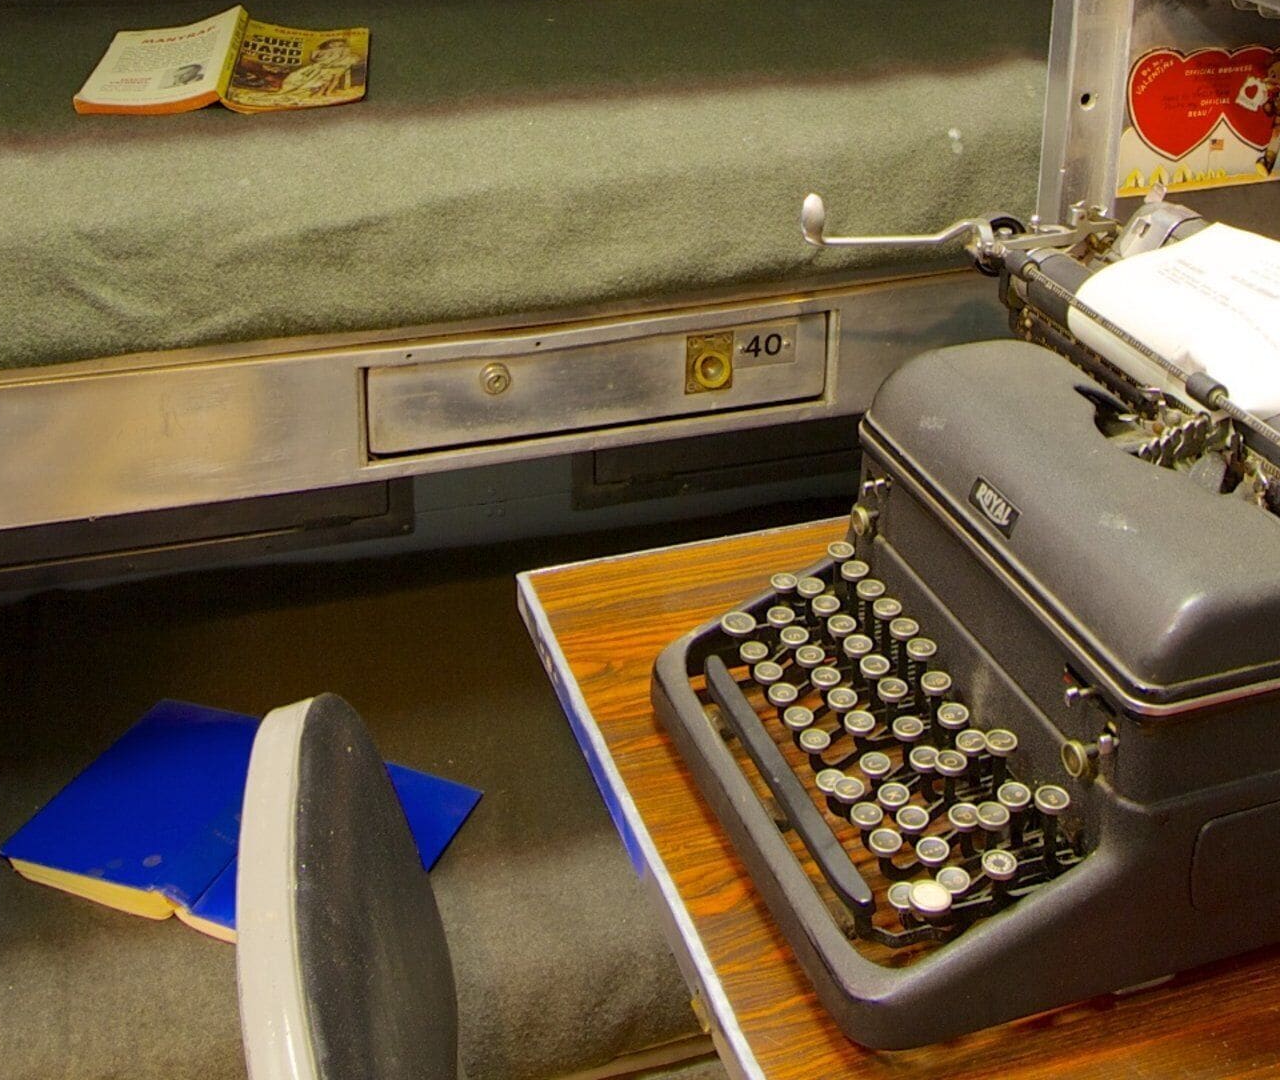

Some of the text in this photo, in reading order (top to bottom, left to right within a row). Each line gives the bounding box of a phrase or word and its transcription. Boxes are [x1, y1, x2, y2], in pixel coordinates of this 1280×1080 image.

[243, 40, 303, 56] HAND
[252, 34, 304, 48] SURE
[258, 53, 302, 66] GOD
[743, 332, 782, 358] 40
[976, 482, 1012, 525] ROYAL
